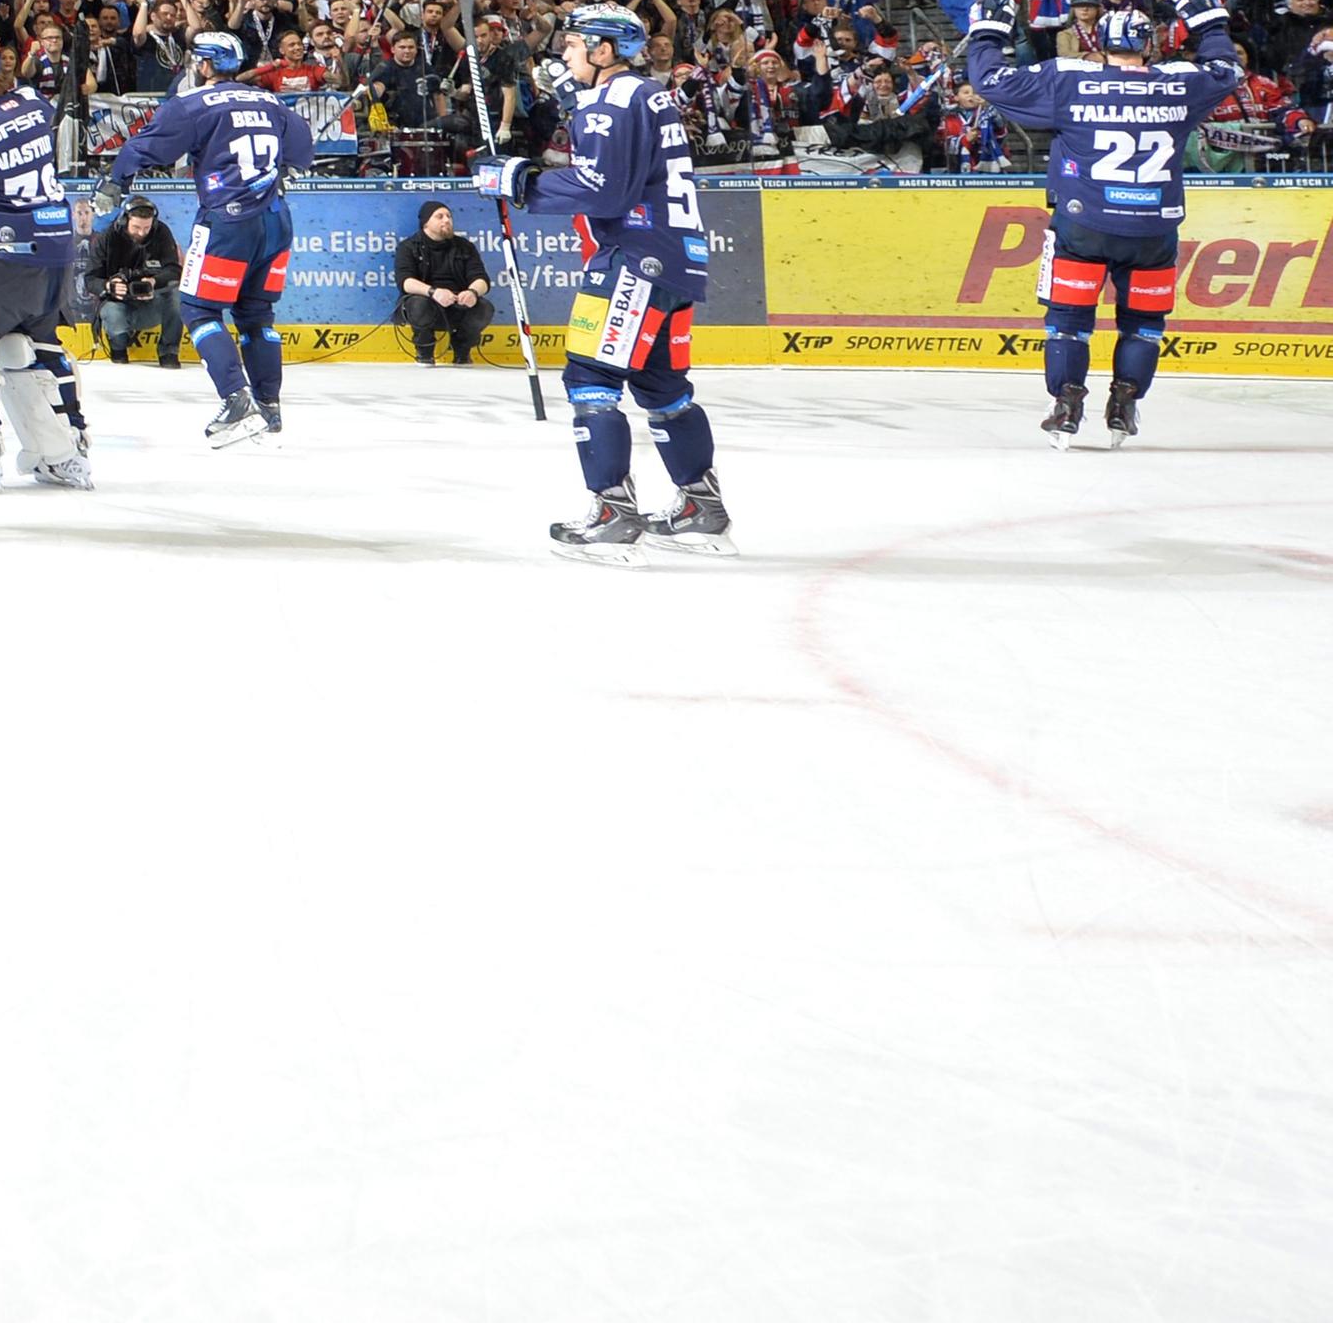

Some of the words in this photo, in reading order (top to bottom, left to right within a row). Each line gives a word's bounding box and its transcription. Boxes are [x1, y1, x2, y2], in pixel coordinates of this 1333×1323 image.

[202, 89, 281, 107] GASAG
[1078, 80, 1187, 96] GASAG
[229, 110, 273, 128] BELL
[1069, 104, 1189, 123] TALLACKSON
[583, 112, 614, 138] 52
[228, 134, 280, 181] 17
[1090, 129, 1175, 184] 22
[401, 181, 451, 191] GASAG
[717, 178, 762, 187] CHRISTIAN
[762, 178, 787, 187] TEICH
[898, 178, 931, 186] HAGEN
[932, 178, 956, 186] POHLE
[1272, 177, 1294, 186] JAN
[1295, 177, 1322, 186] ESCH
[665, 156, 704, 233] 5
[330, 228, 400, 253] Eisbä
[601, 272, 639, 357] DWB-BAU
[312, 328, 360, 350] X-TiP
[783, 331, 833, 354] X-TiP
[844, 334, 983, 353] SPORTWETTEN
[1161, 336, 1217, 359] X-TiP
[1233, 339, 1333, 359] SPORTWE
